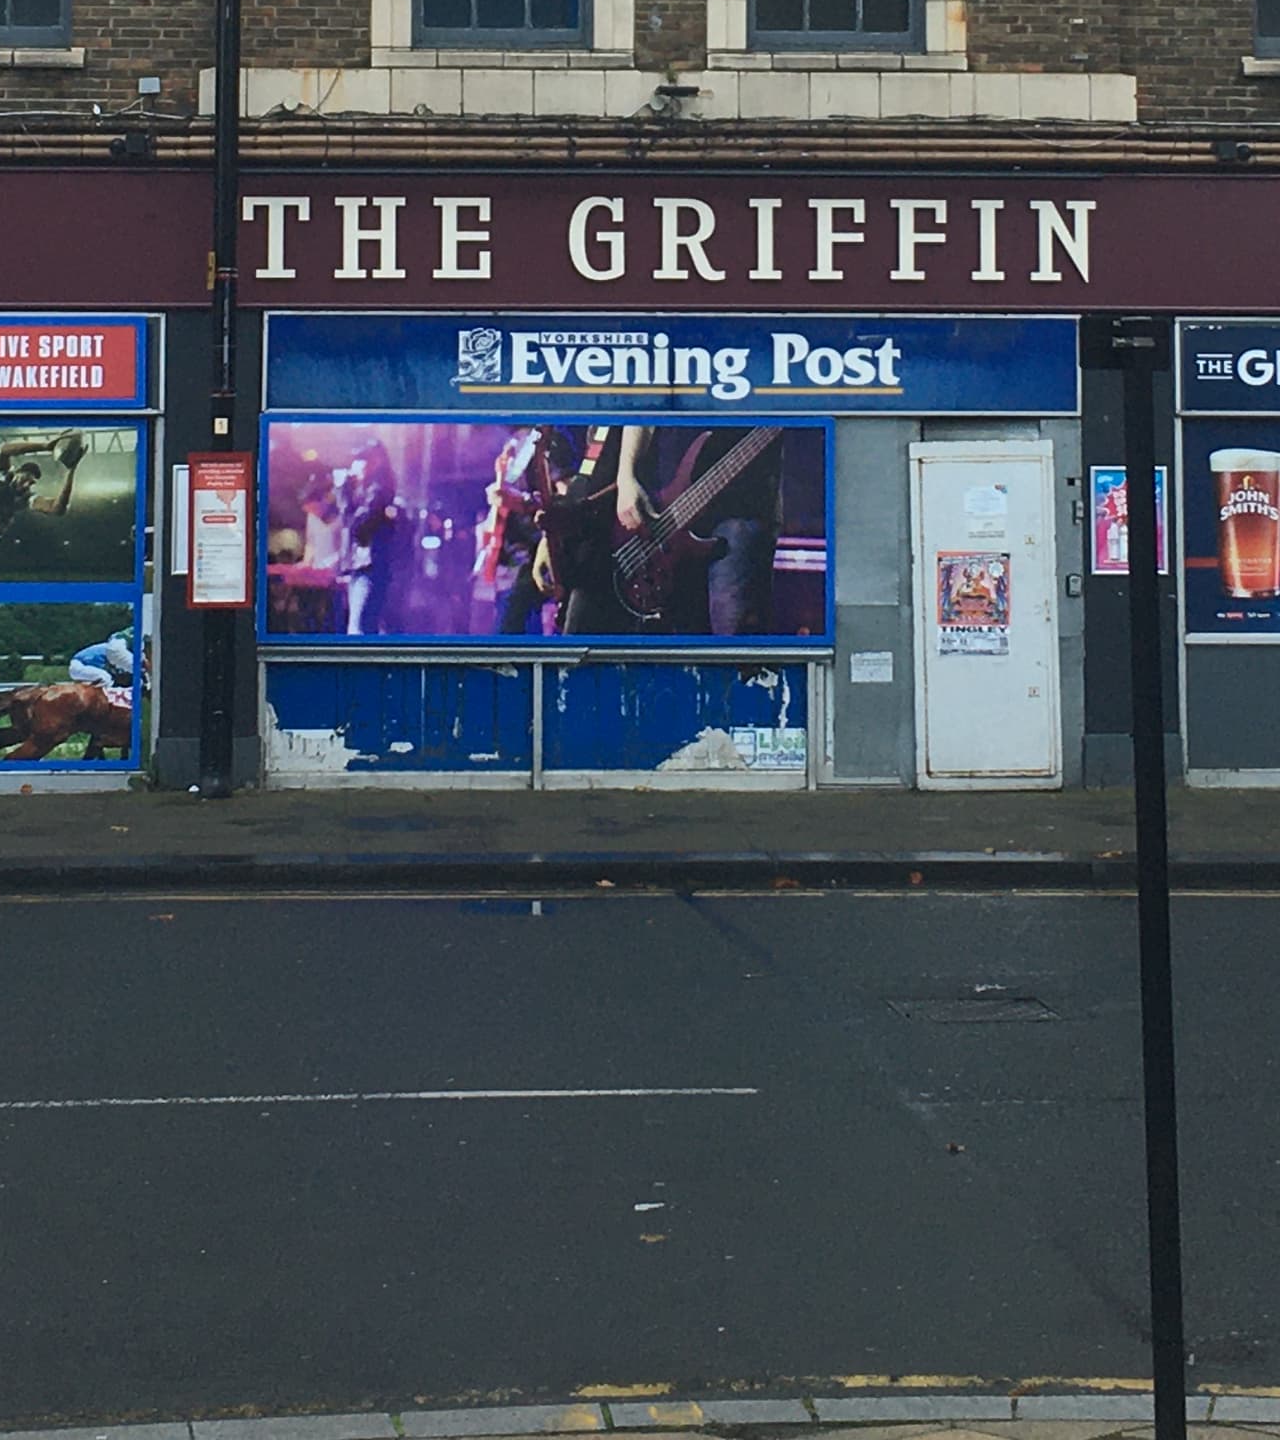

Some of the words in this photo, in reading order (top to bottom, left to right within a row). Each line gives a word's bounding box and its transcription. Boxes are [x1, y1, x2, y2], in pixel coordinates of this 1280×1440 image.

[242, 196, 492, 280] THE
[568, 196, 1097, 283] GRIFFIN
[38, 335, 105, 359] SPORT
[541, 332, 648, 345] YORKSHIRE
[510, 333, 750, 400] Evening
[772, 333, 902, 388] Post
[1197, 360, 1233, 374] THE
[1227, 490, 1269, 505] JOHN
[1220, 502, 1280, 521] SMITH'S
